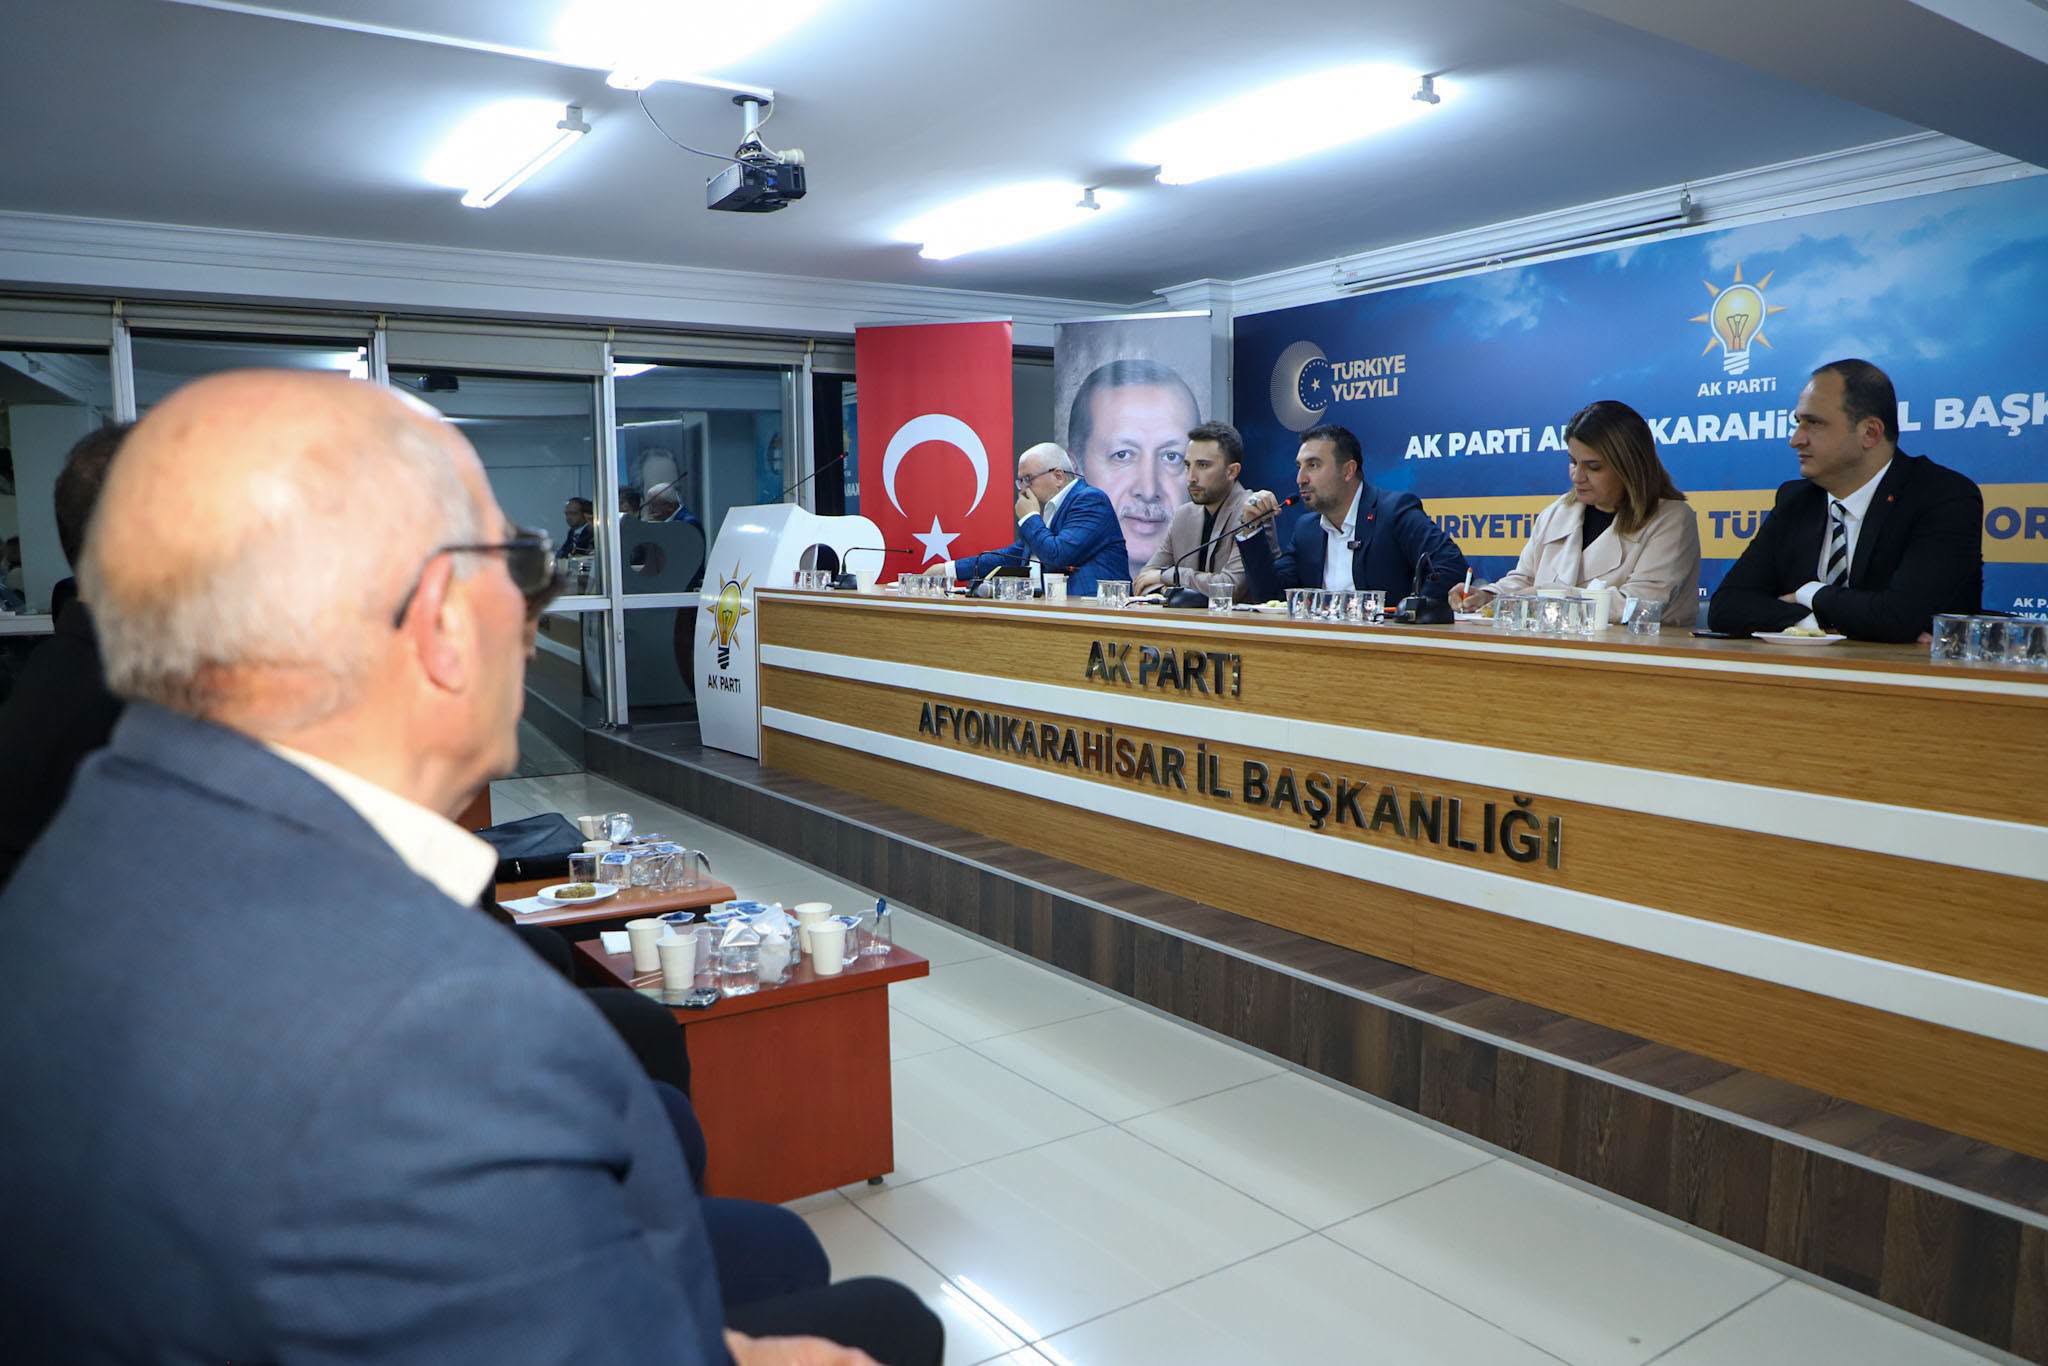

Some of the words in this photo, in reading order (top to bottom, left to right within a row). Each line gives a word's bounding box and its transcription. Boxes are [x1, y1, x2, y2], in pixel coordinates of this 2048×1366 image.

[1697, 382, 1722, 397] AK
[1404, 434, 1442, 459] AK
[1085, 640, 1132, 684] AK
[708, 674, 718, 690] AK
[918, 701, 1187, 791] AFYONKARAHİSAR
[1197, 743, 1232, 798] İL
[1243, 760, 1562, 870] BAŞKANLIĞI
